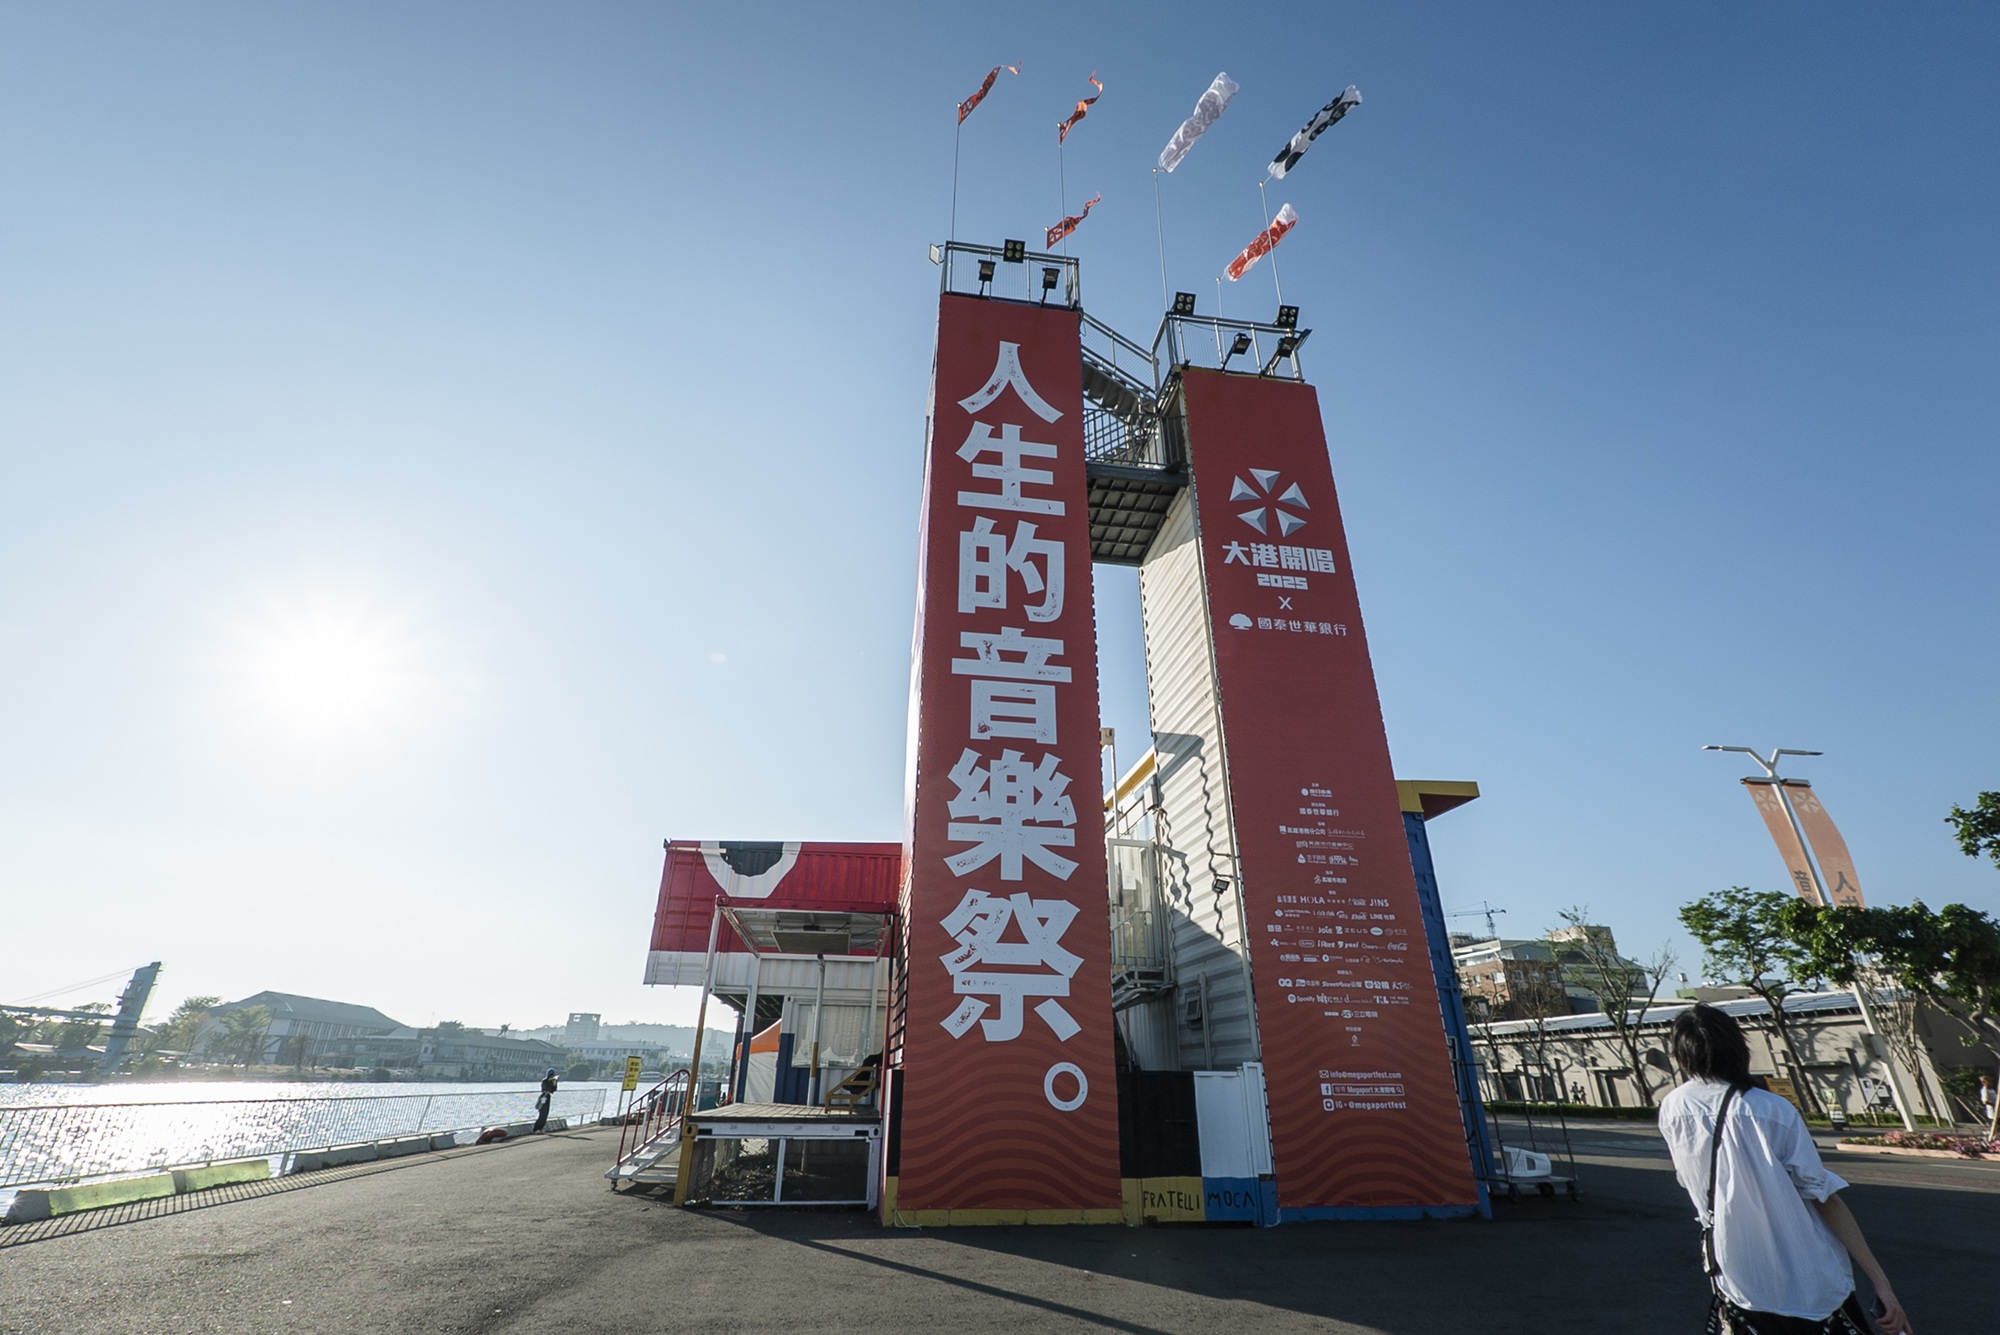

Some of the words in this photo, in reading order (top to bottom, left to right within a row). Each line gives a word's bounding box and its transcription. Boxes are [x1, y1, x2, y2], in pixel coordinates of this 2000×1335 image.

[1222, 541, 1336, 574] 大港開唱
[1256, 573, 1309, 590] 2025
[1257, 617, 1347, 637] 國泰世華銀行
[1300, 896, 1326, 904] HOLA
[1369, 899, 1390, 907] JINS
[1143, 1191, 1200, 1211] FRATELLI
